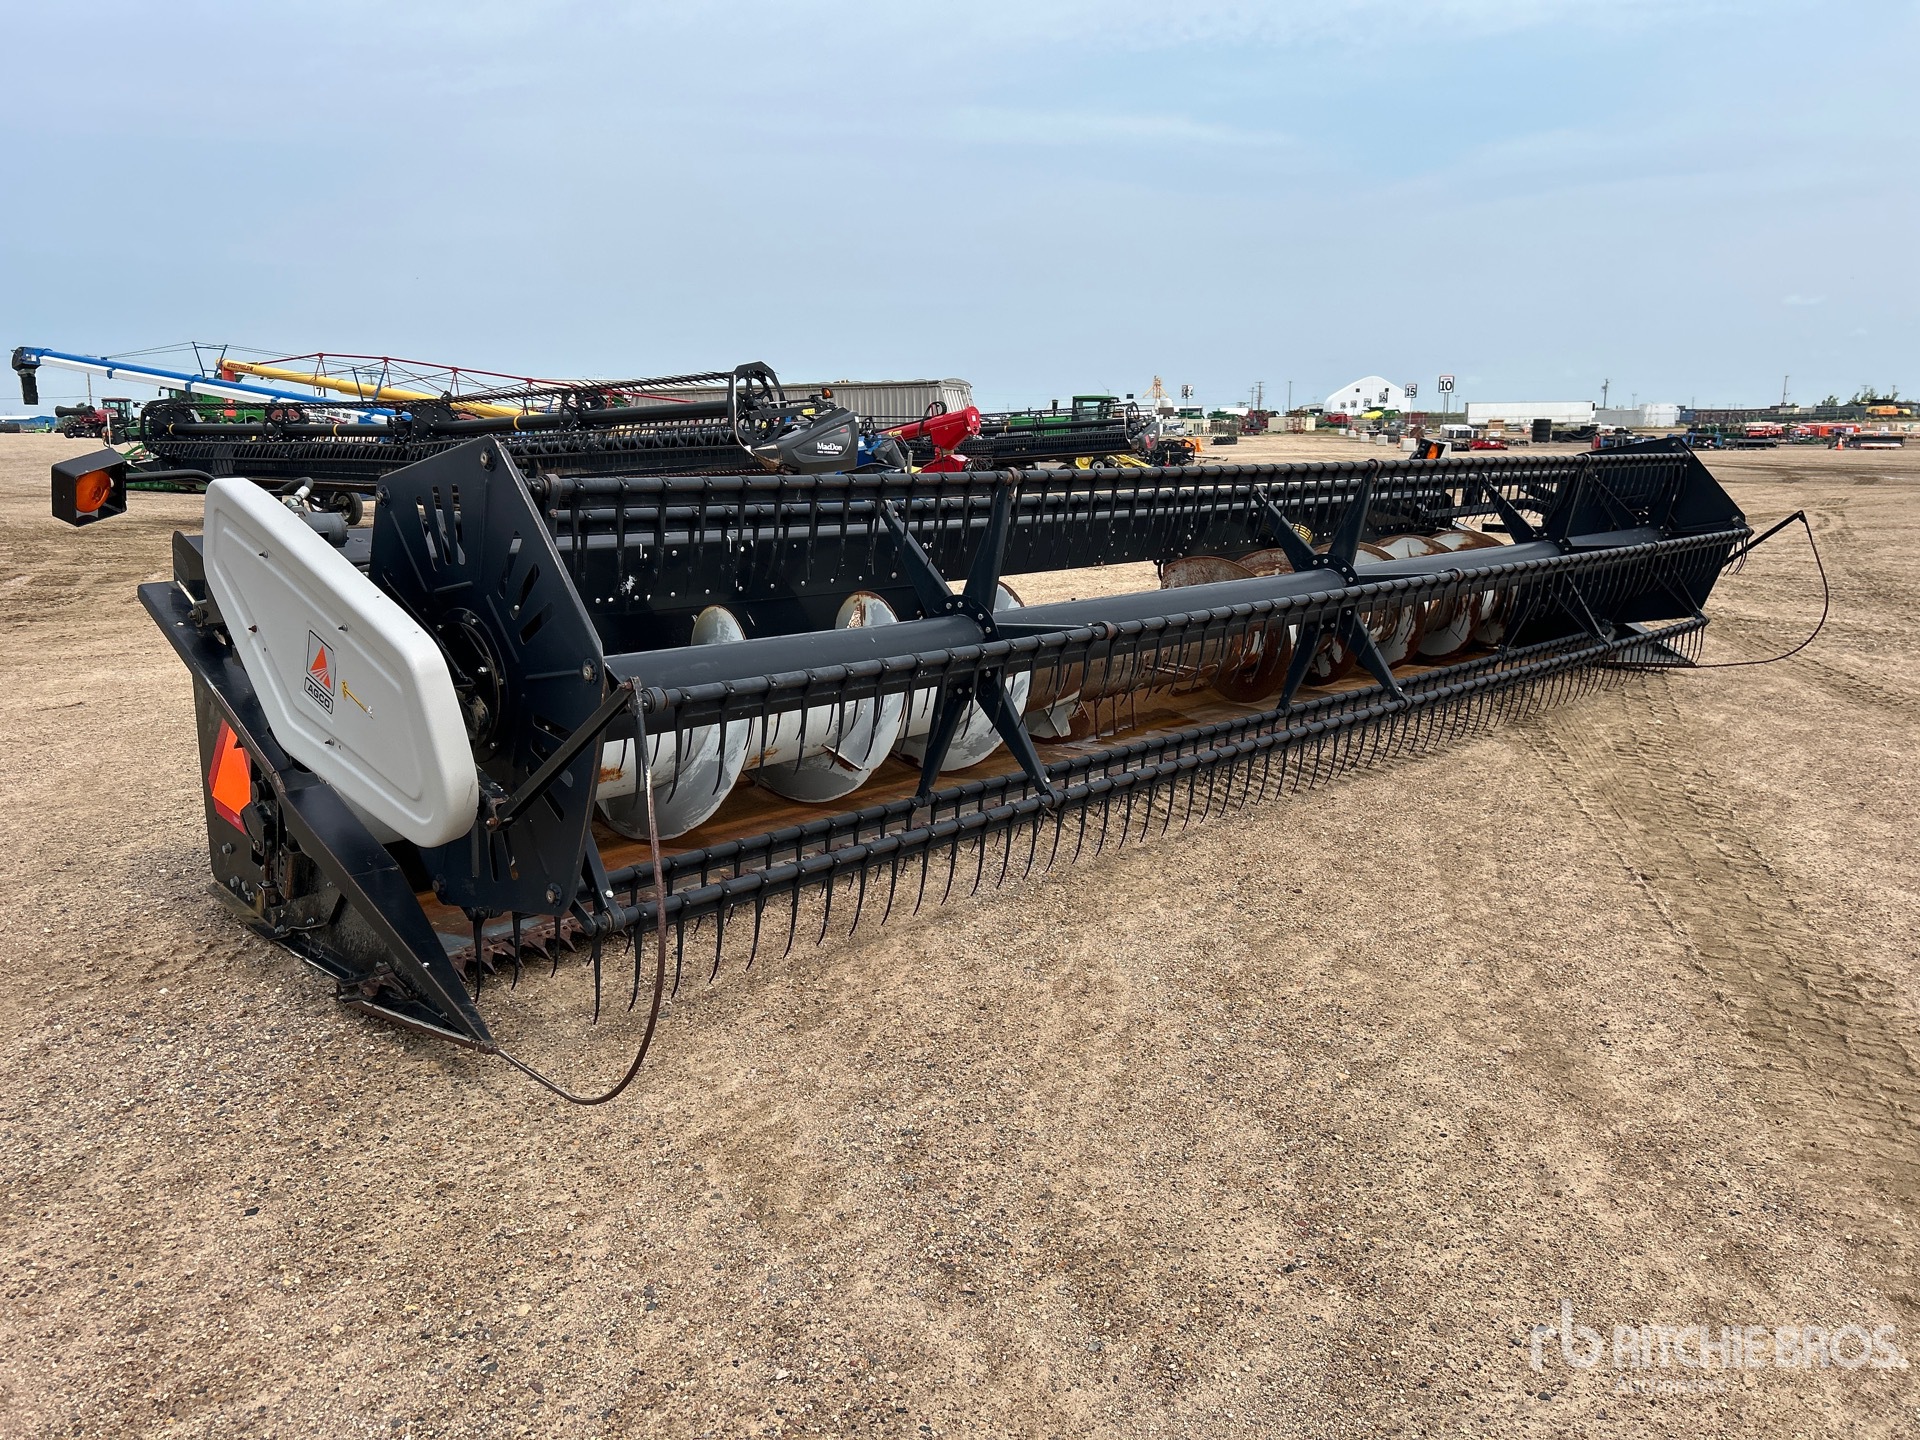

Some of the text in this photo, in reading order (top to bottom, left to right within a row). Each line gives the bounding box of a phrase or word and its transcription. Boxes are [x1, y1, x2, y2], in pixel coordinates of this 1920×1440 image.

[1440, 381, 1452, 391] 10
[1406, 388, 1416, 396] 15
[817, 442, 842, 451] MacDon
[307, 684, 330, 709] AGCO
